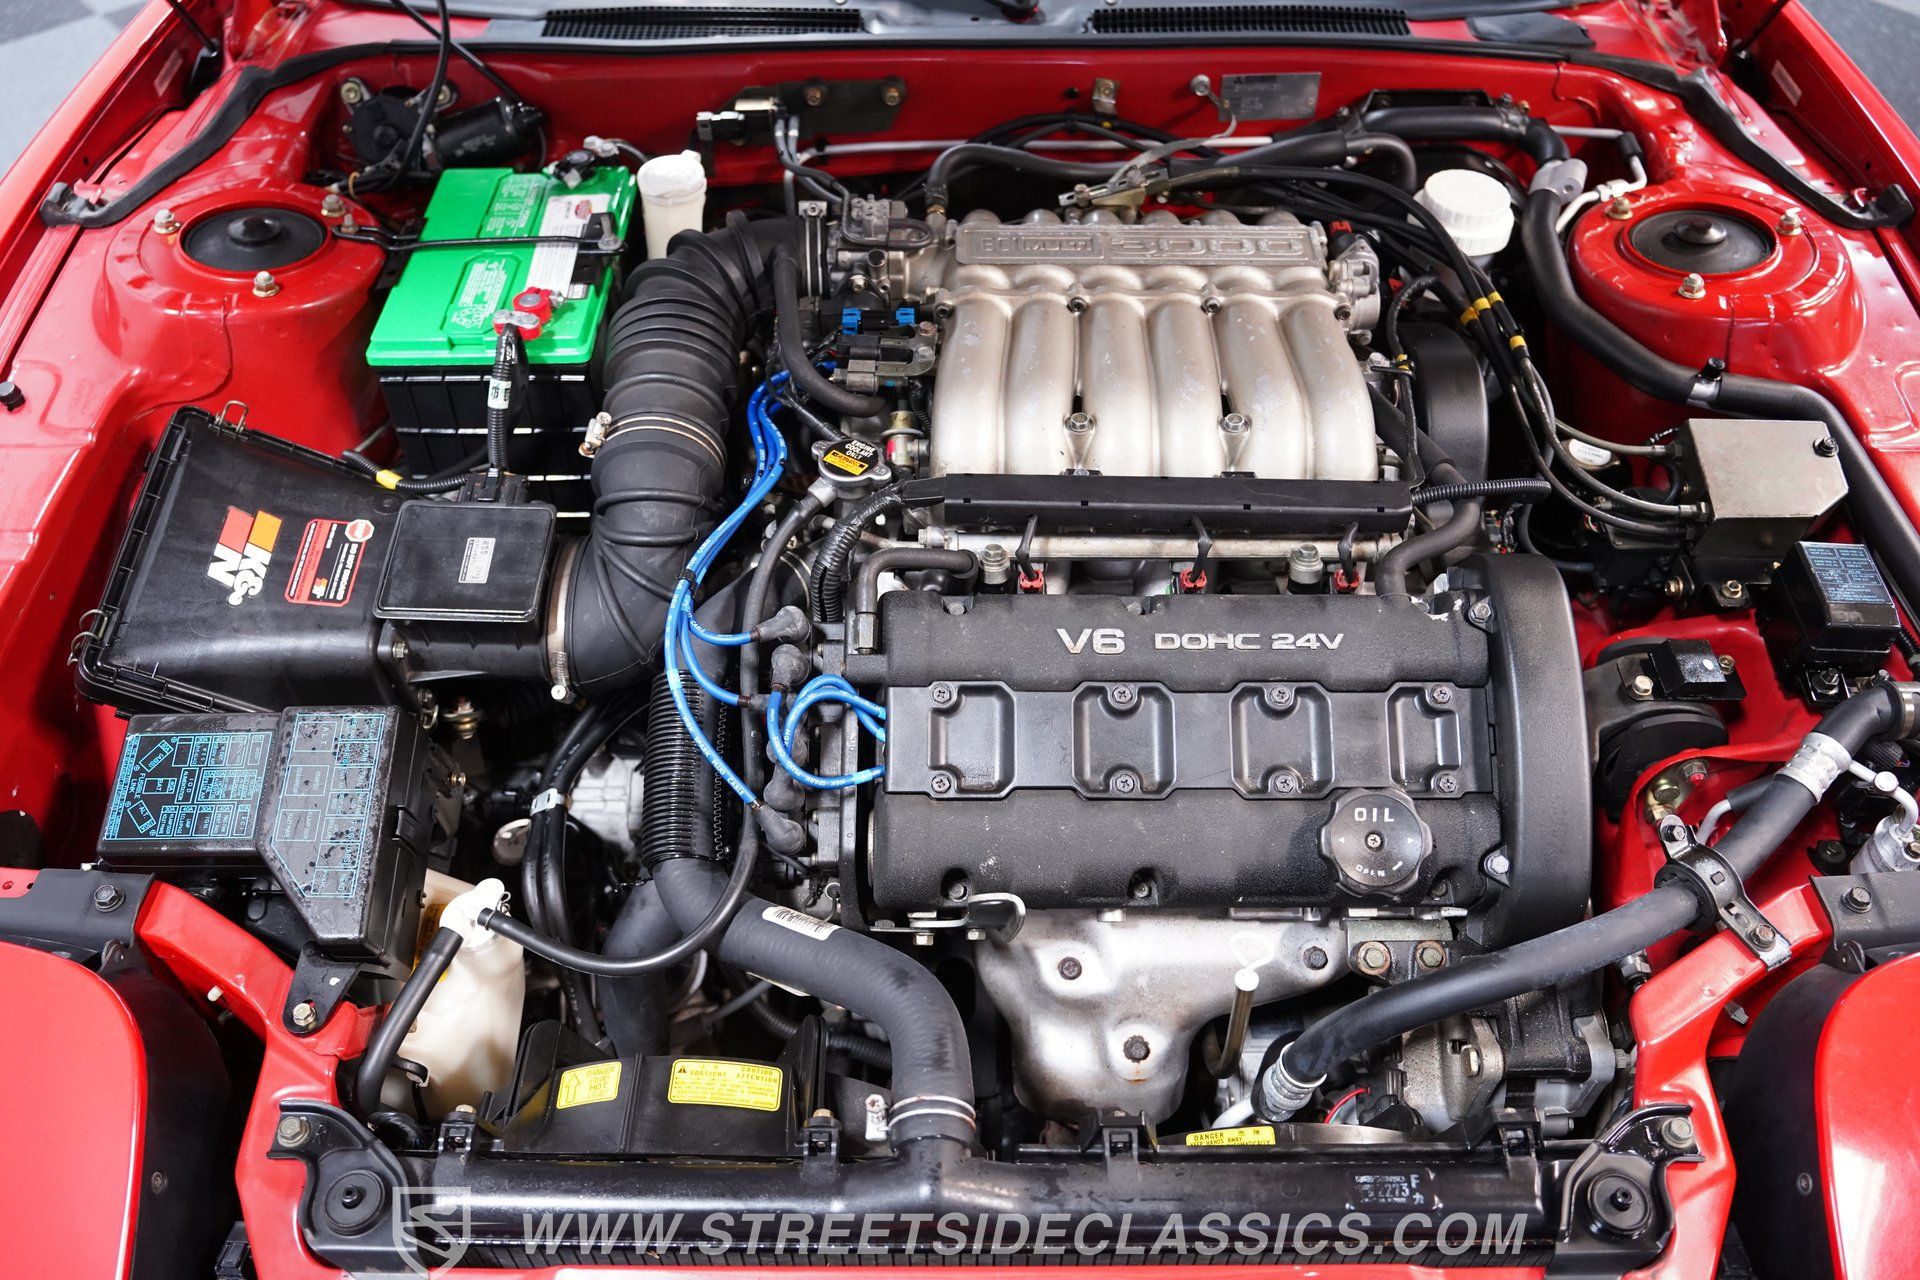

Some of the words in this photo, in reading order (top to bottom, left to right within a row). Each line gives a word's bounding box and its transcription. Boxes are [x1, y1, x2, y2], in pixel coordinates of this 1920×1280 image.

[845, 444, 873, 458] COOLANT
[851, 440, 875, 453] ENGINE
[846, 450, 863, 459] ONLY
[1056, 628, 1125, 654] V6
[1154, 633, 1261, 650] DOHC
[1271, 633, 1345, 650] 24V
[1354, 807, 1395, 823] OIL
[1355, 864, 1386, 877] OPEN
[1193, 1132, 1224, 1142] DANGER
